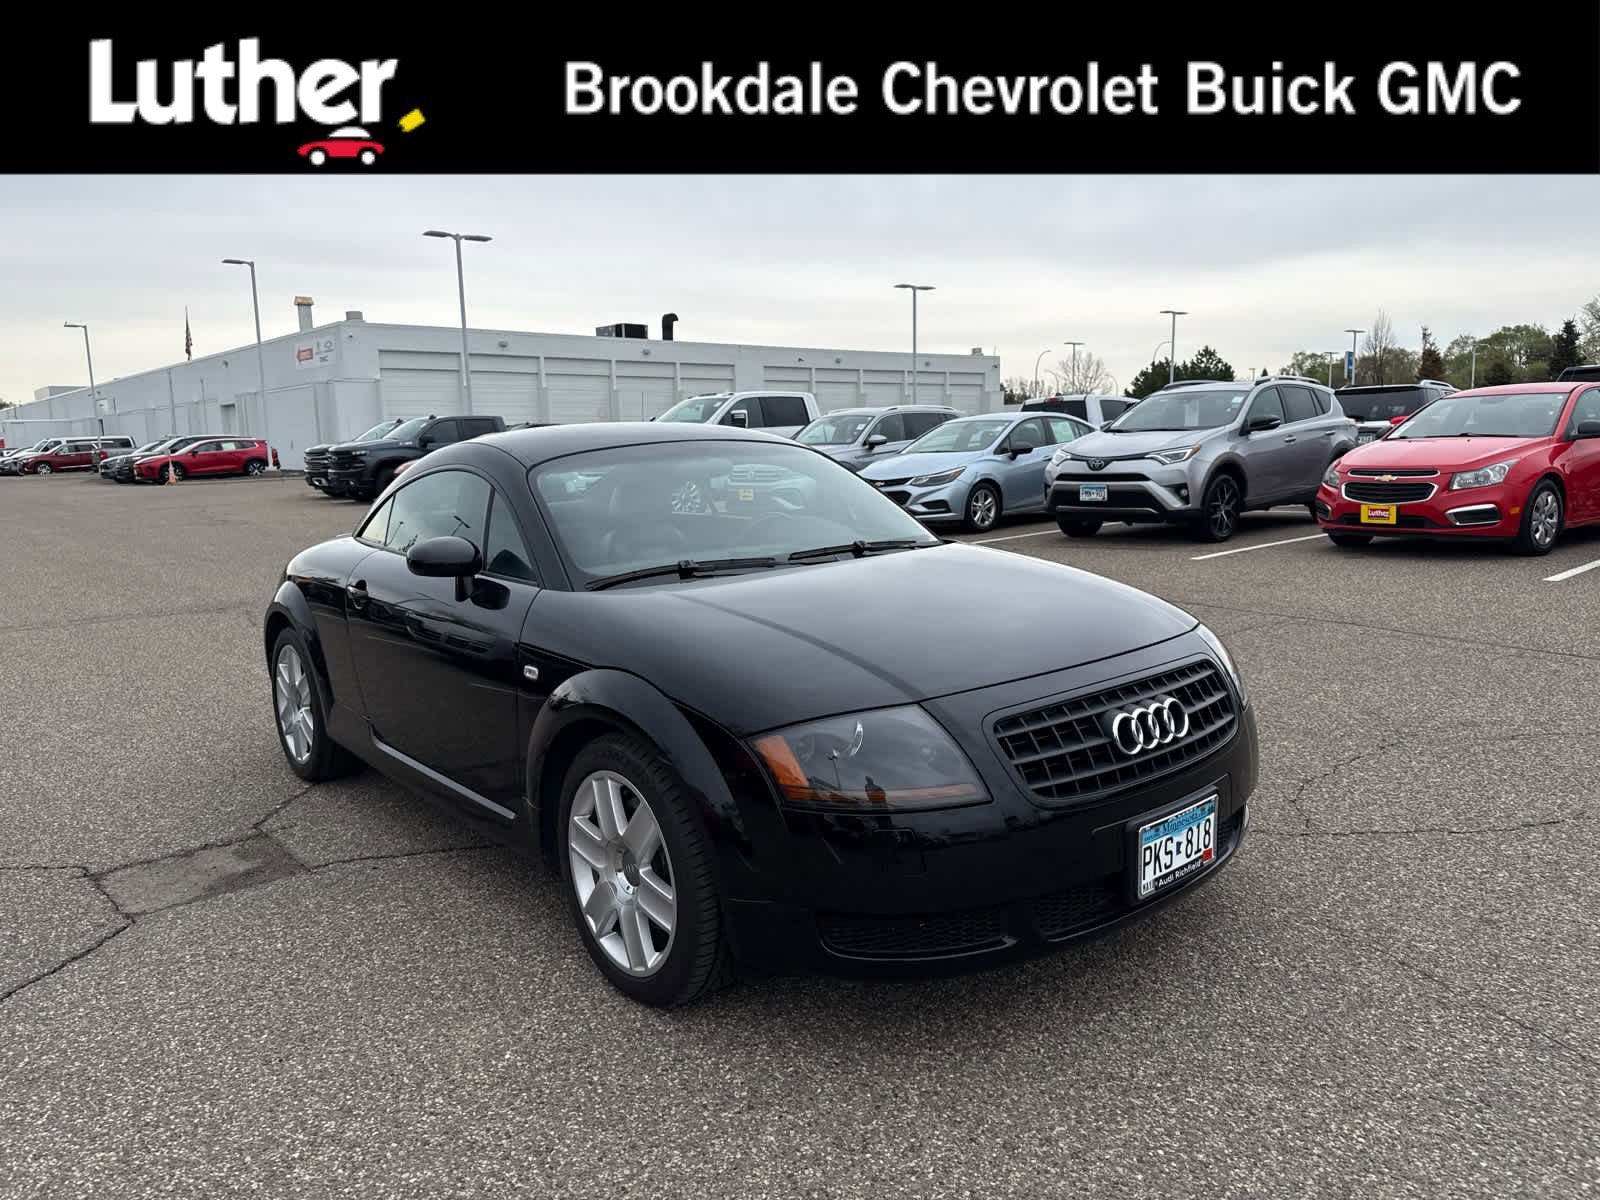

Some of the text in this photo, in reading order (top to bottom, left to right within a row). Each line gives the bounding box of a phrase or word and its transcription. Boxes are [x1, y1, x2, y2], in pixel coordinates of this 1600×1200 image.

[1143, 818, 1211, 880] PKS 818
[1158, 860, 1201, 888] Audi Richfield
